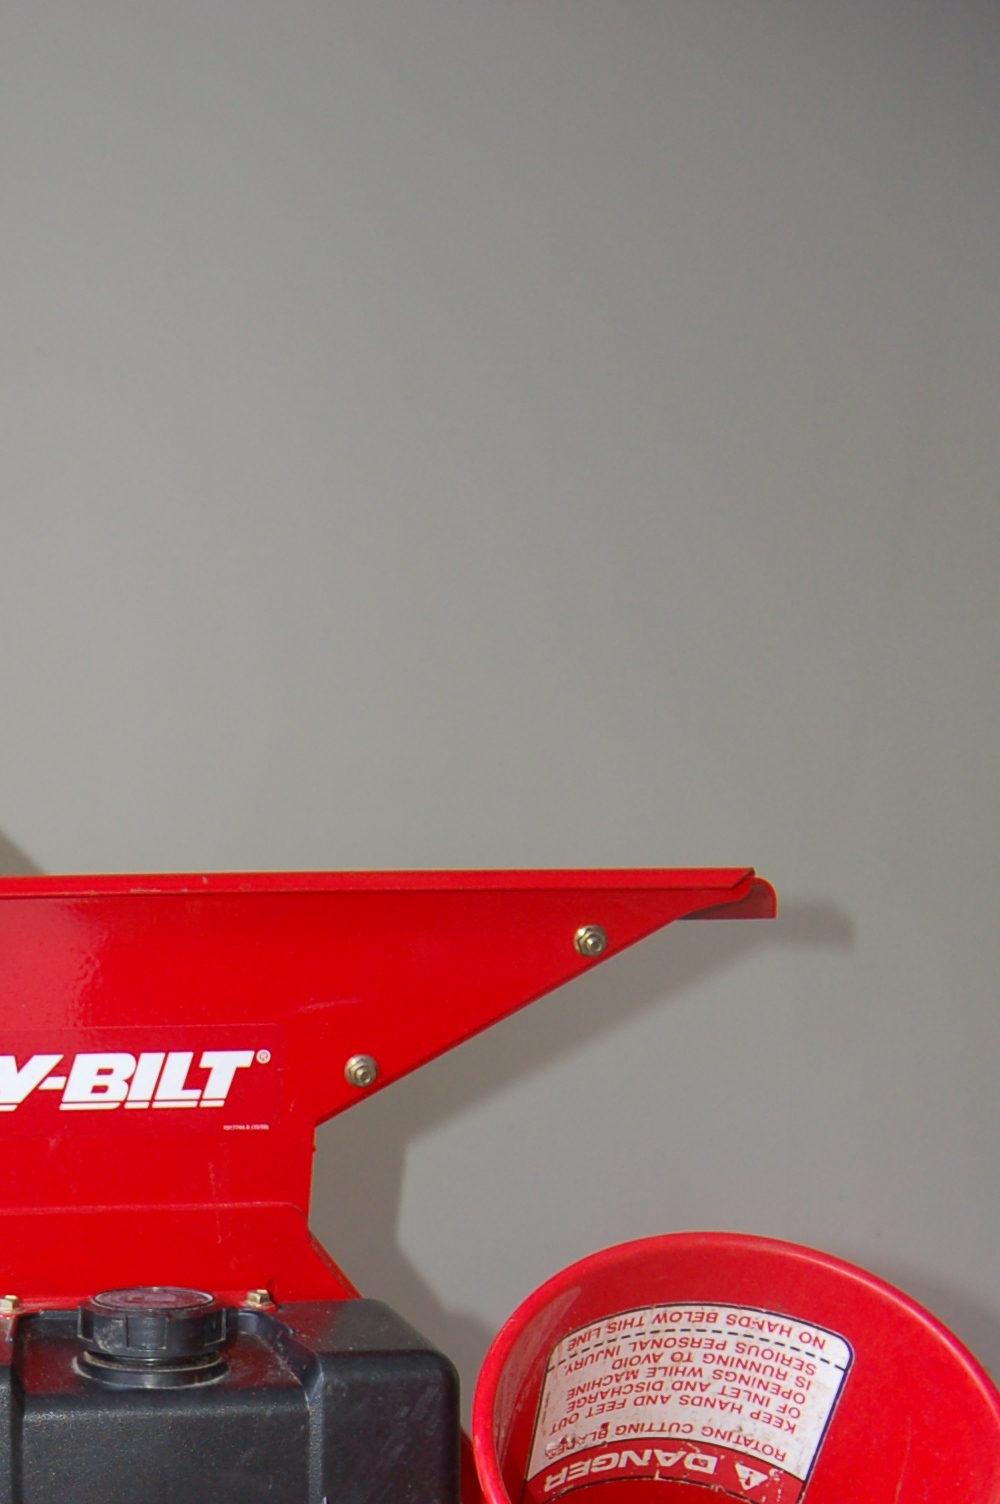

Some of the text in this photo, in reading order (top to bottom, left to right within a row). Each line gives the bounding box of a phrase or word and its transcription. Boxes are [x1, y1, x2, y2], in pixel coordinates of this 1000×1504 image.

[568, 1311, 827, 1350] NO HANDS BELOW THIS LINE
[629, 1336, 727, 1351] PERSONAL
[611, 1351, 811, 1391] IS RUNNING TO AVOID
[735, 1341, 817, 1376] SERIOUS
[566, 1366, 806, 1405] OPENINGS WHILE MACHINE
[566, 1380, 664, 1413] DISCHARGE
[671, 1380, 711, 1393] AND
[717, 1385, 771, 1408] INLET
[550, 1394, 797, 1436] KEEP HANDS AND FEET OUT
[615, 1422, 693, 1436] CUTTING
[776, 1404, 801, 1420] OF
[701, 1425, 787, 1462] ROTATING
[543, 1449, 718, 1493] DANGER
